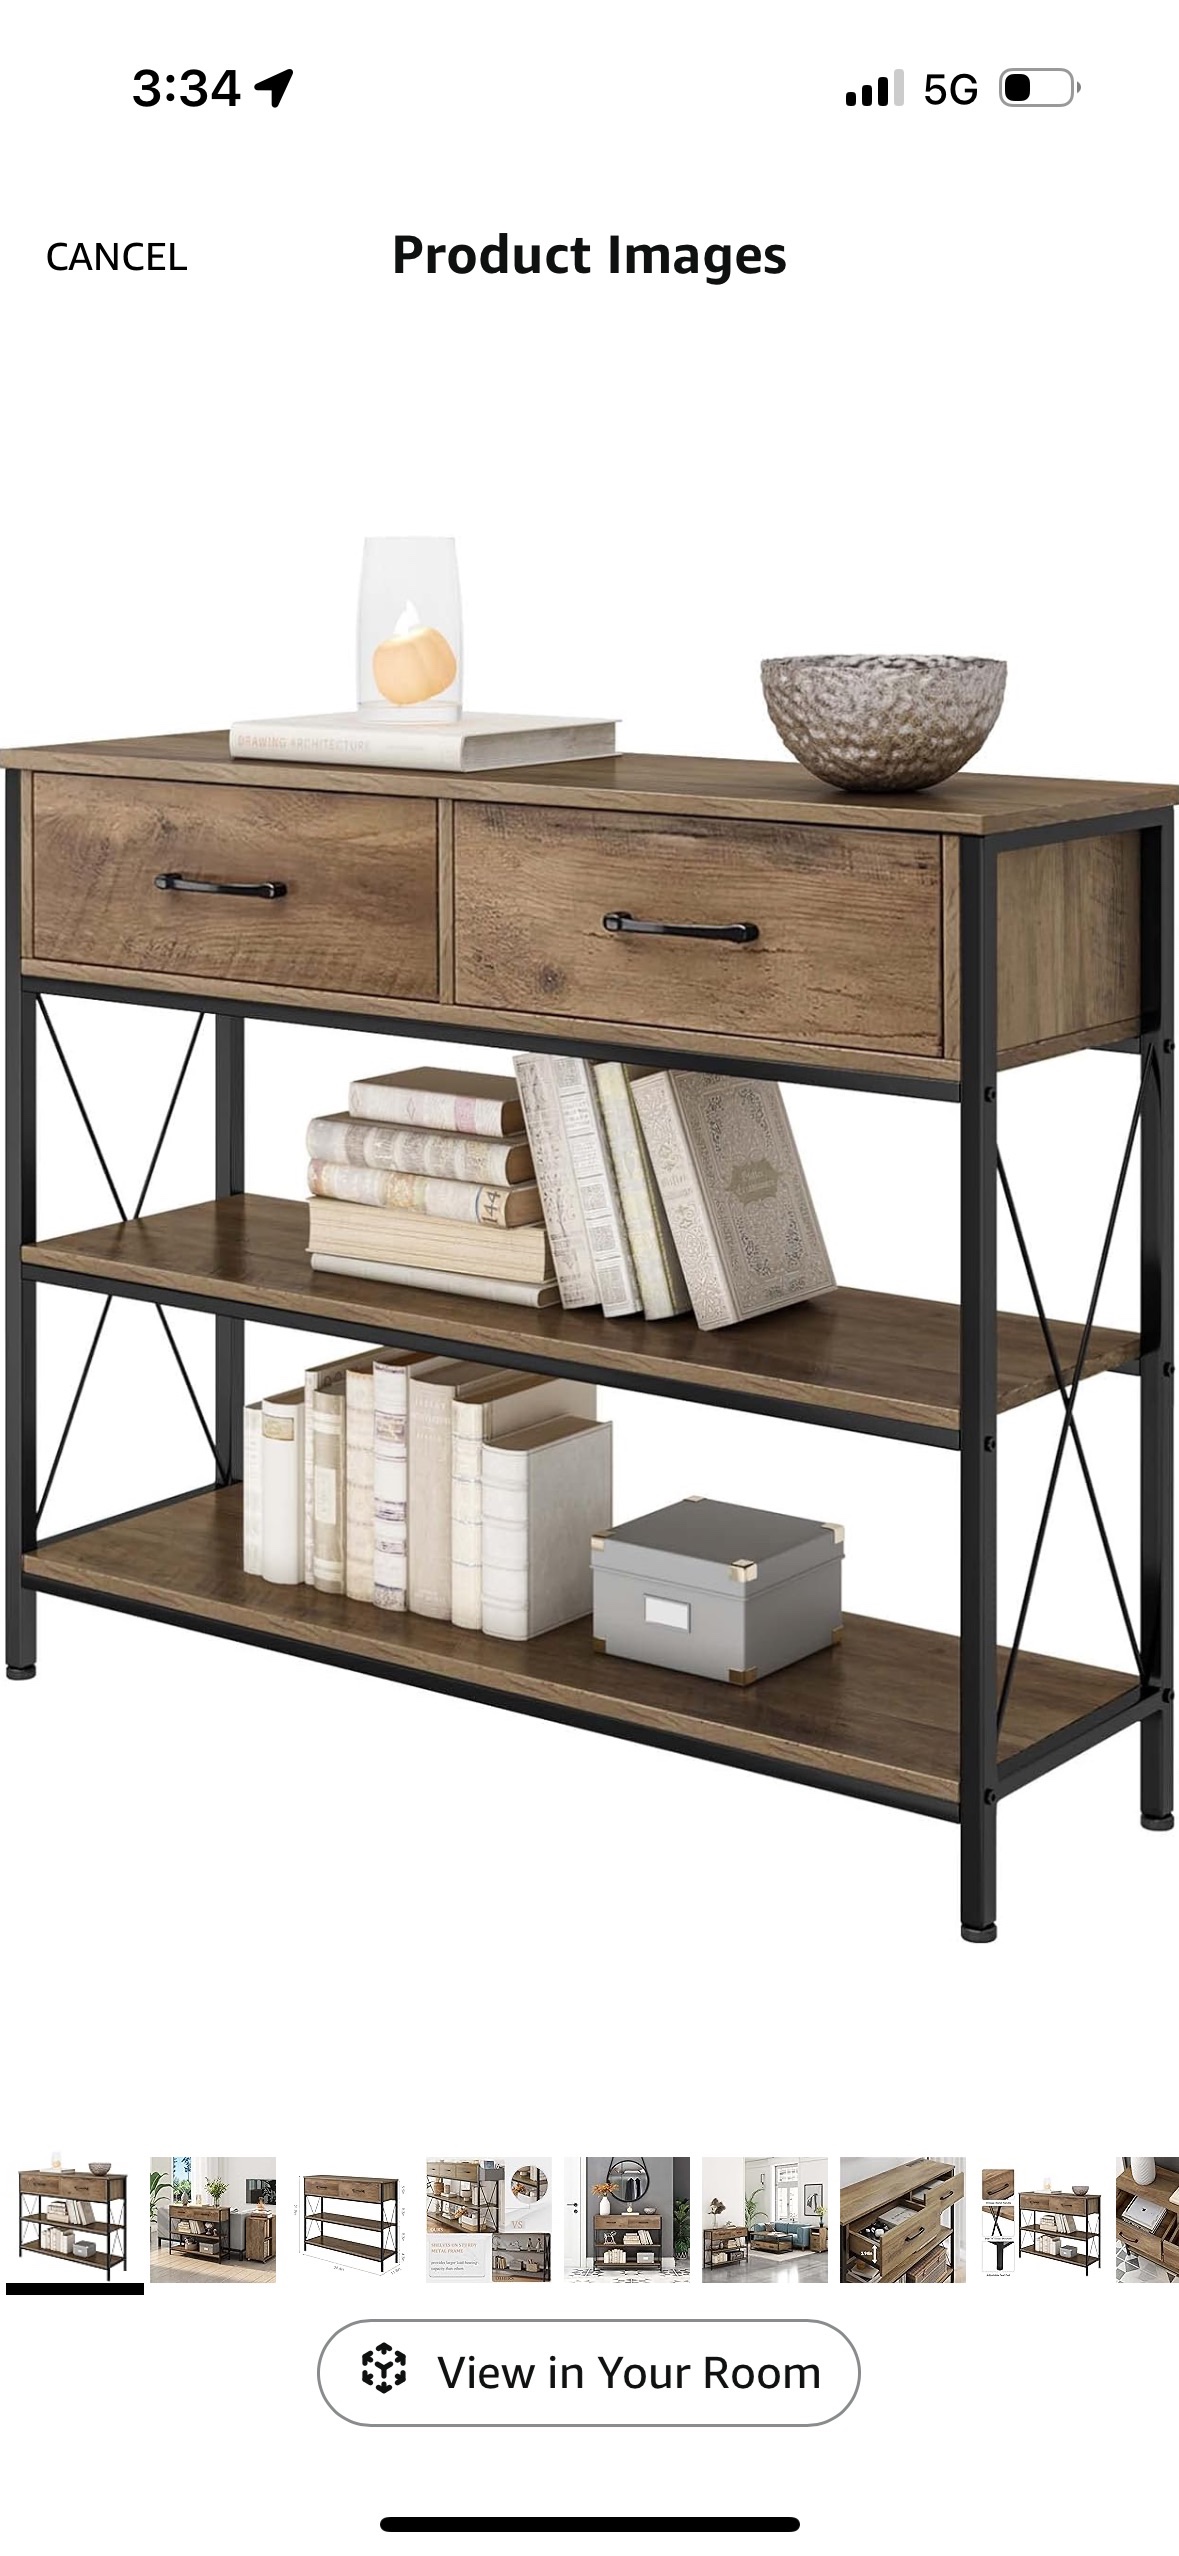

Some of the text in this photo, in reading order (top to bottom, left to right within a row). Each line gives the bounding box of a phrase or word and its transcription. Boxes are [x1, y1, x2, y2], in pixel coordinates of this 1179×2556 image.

[132, 68, 241, 108] 3:34
[924, 73, 978, 106] 5G
[46, 241, 188, 272] CANCEL
[394, 232, 787, 286] Product Images
[238, 735, 288, 749] DRAWING
[480, 1190, 502, 1224] 144
[437, 2355, 820, 2390] View in Your Room
